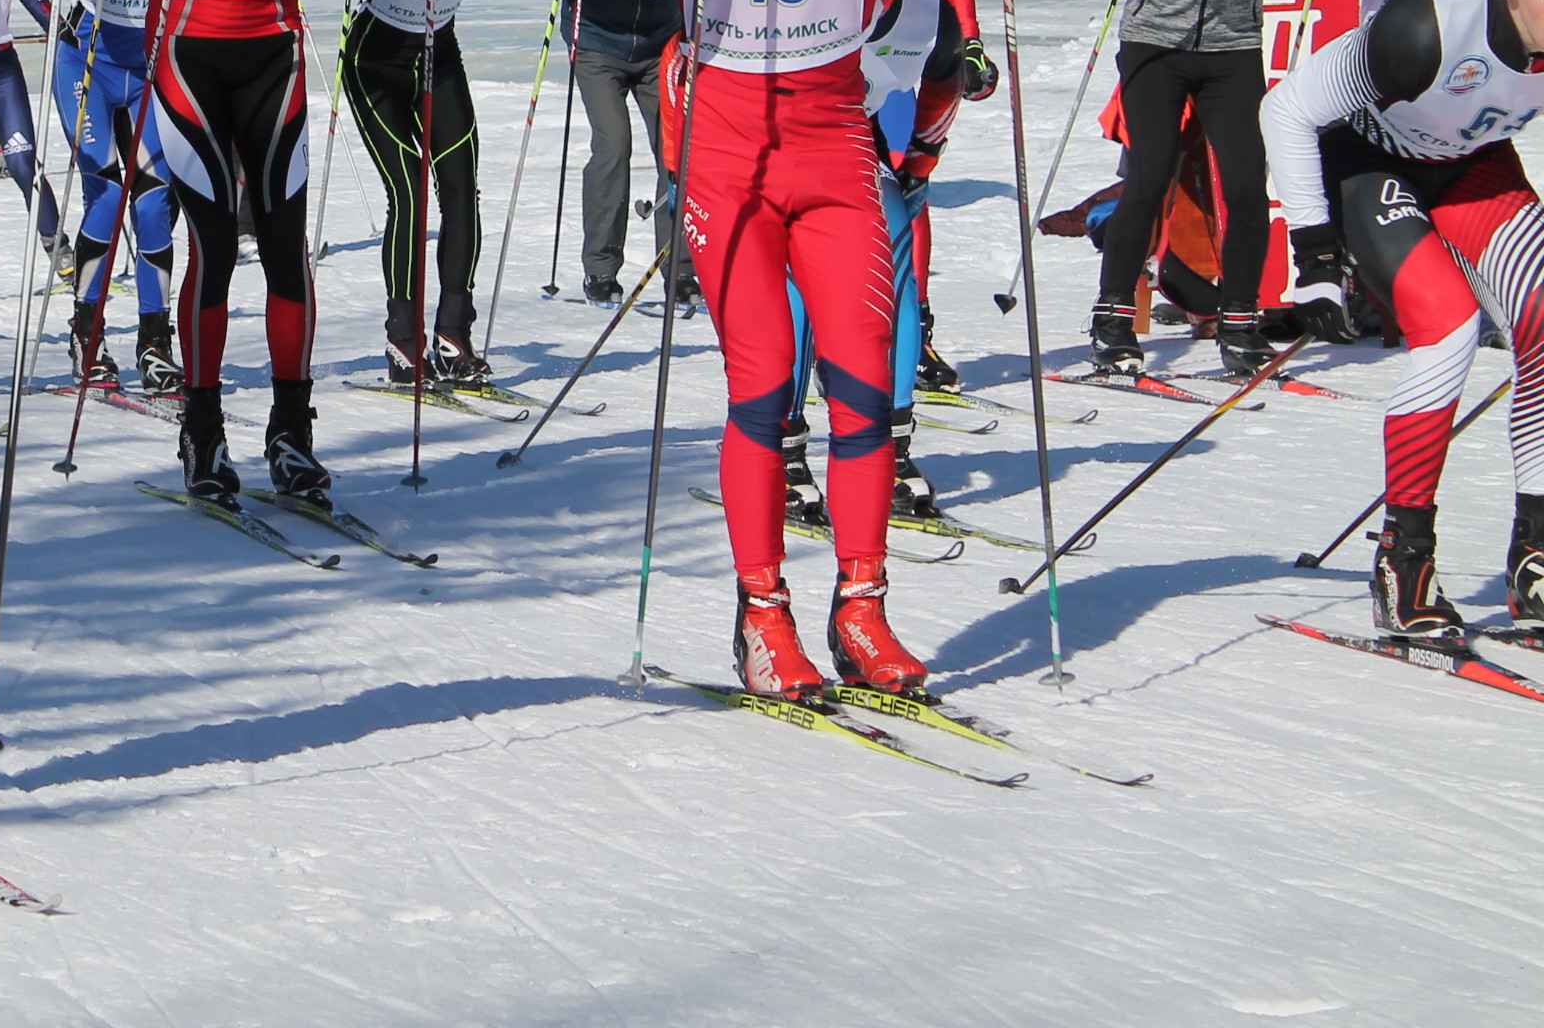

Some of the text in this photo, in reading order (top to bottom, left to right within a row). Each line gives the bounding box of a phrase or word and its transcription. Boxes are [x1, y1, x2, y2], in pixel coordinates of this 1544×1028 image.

[3, 142, 33, 155] adidas
[685, 195, 711, 222] РУСАЛ
[845, 621, 880, 659] alpina
[1408, 647, 1456, 673] ROSSIGNOL
[740, 696, 815, 730] FISCHER
[839, 689, 920, 721] FISCHER
